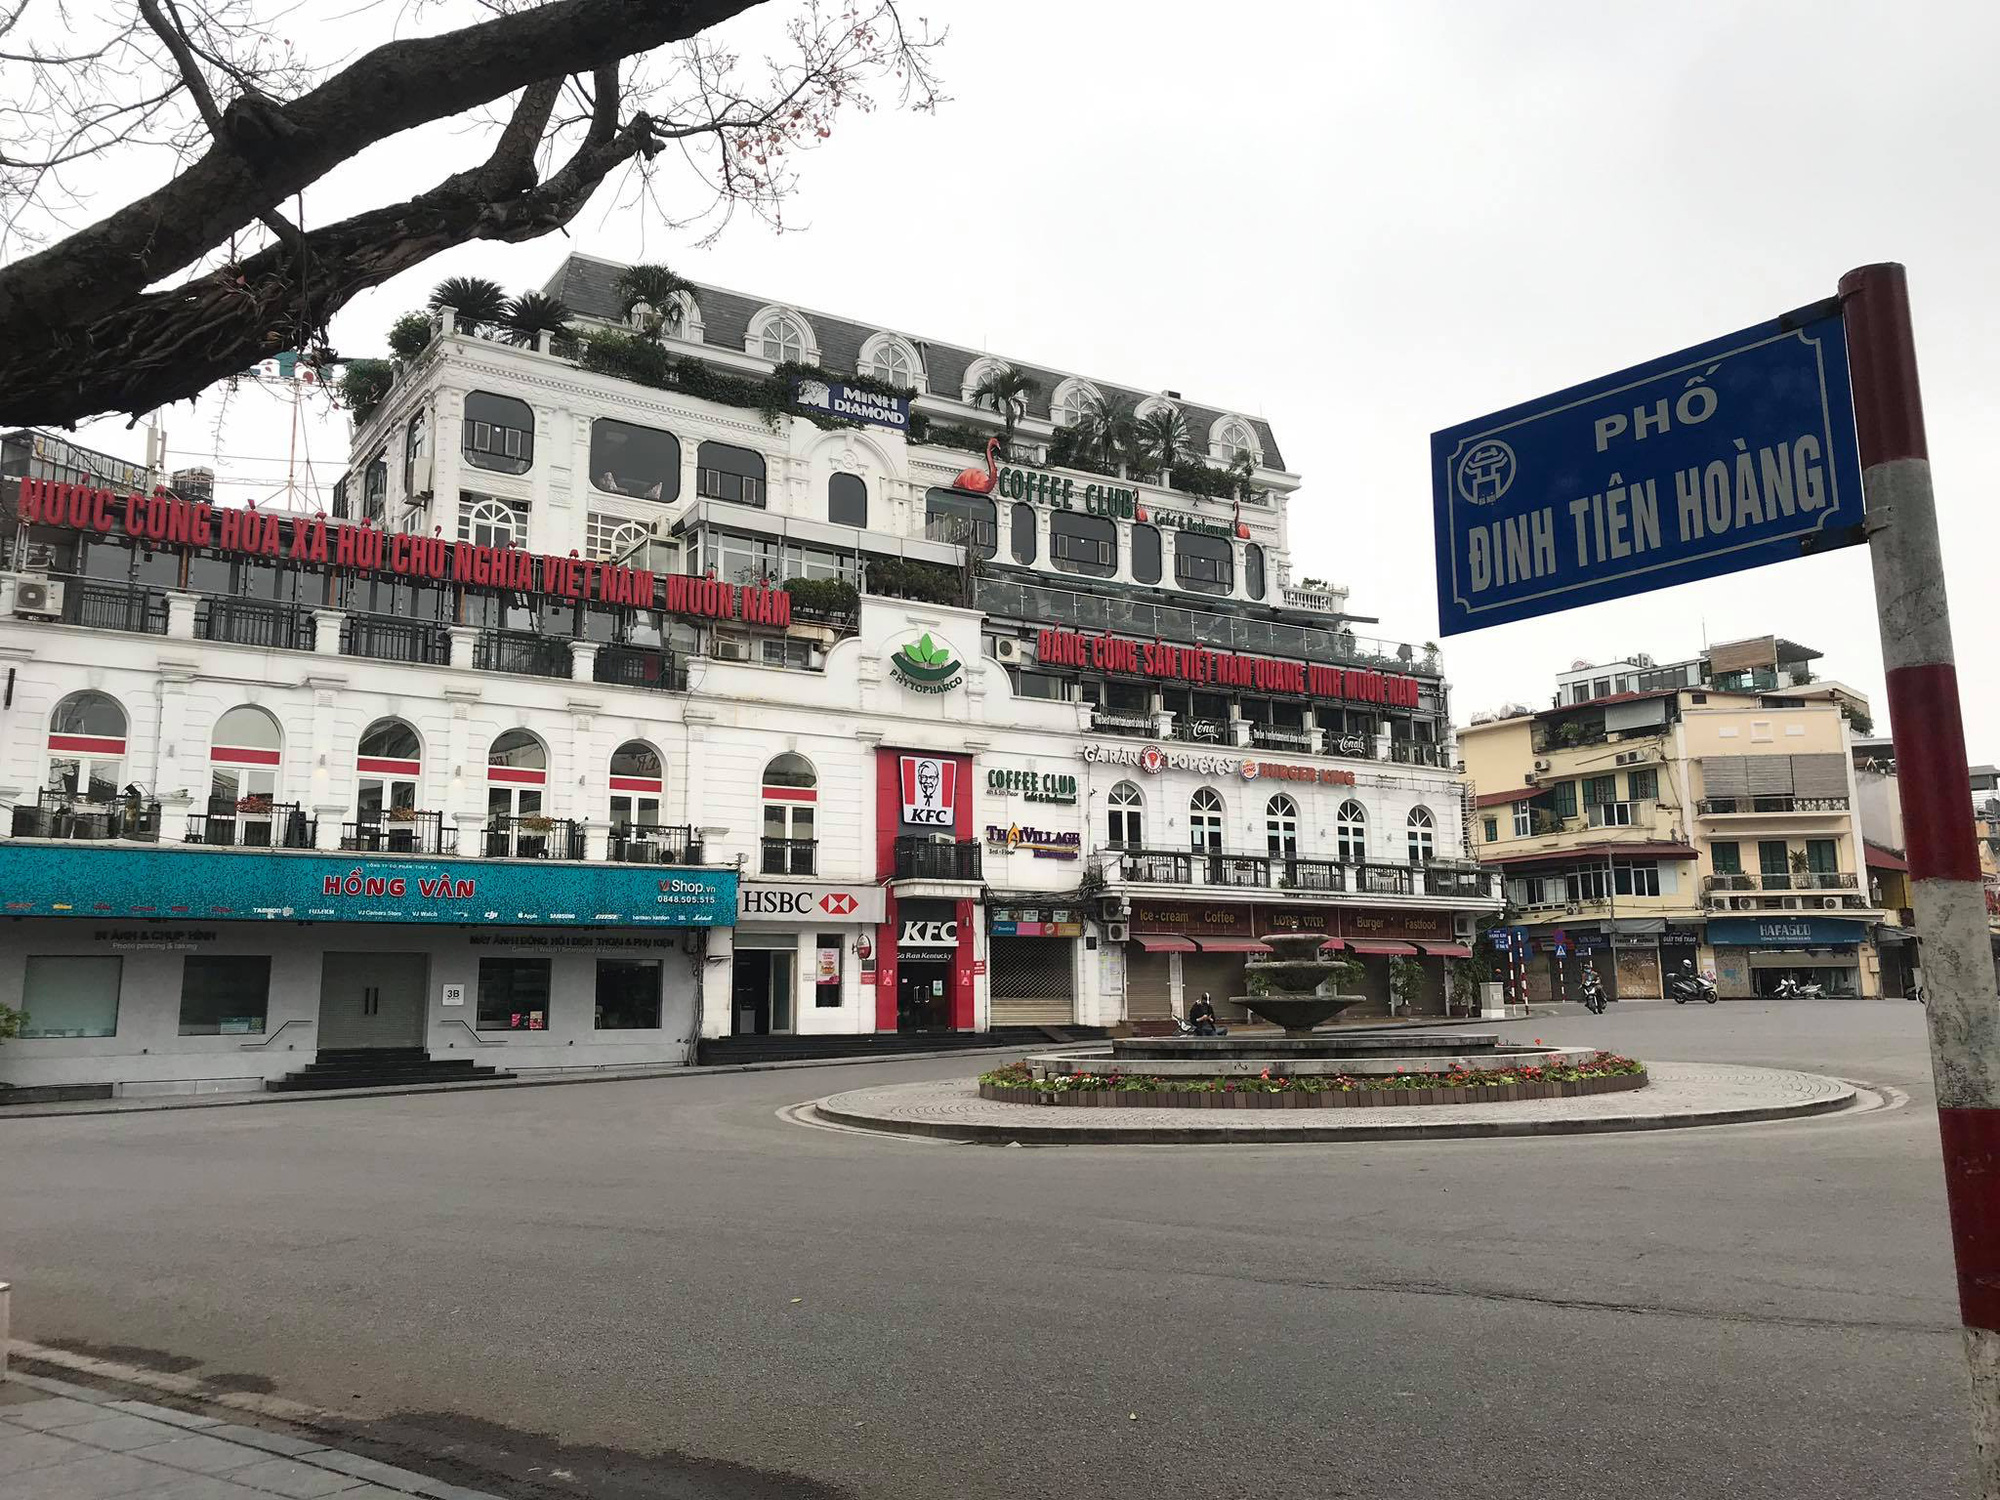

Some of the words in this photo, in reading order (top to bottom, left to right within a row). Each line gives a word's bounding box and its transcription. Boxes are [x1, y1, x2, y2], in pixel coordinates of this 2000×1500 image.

[843, 387, 898, 410] MINH
[1594, 363, 1721, 453] PHỐ
[834, 399, 905, 425] DIAMOND
[1000, 466, 1074, 510] COFFEE
[1085, 484, 1134, 519] CLUB
[1154, 511, 1176, 527] Café
[1177, 515, 1185, 529] &
[1187, 516, 1235, 536] Restaurant
[1468, 506, 1557, 593] ĐINH
[1570, 472, 1661, 568] TIÊN
[1675, 434, 1825, 543] HOÀNG
[18, 469, 115, 531] NƯỚC
[124, 484, 212, 548] CỘNG
[290, 511, 328, 563] XÃ
[337, 517, 384, 578] HỘI
[391, 525, 447, 578] CHỦ
[453, 541, 533, 592] NGHĨA
[543, 549, 596, 605] VIỆT
[599, 563, 655, 608] NAM
[666, 570, 735, 618] MUÔN
[741, 578, 791, 627] NĂM
[1038, 620, 1088, 667] ĐẢNG
[1092, 629, 1138, 677] CỘNG
[1143, 634, 1178, 677] SẢN
[1179, 642, 1214, 688] VIỆT
[1216, 652, 1252, 686] NAM
[1253, 657, 1305, 693] QUANG
[1307, 664, 1343, 698] VINH
[1344, 662, 1386, 704] MUÔN
[1387, 671, 1420, 708] NĂM
[889, 669, 963, 694] PHYTOPHARCO
[1083, 744, 1108, 762] GÀ
[1109, 747, 1142, 767] RÁN
[987, 769, 1039, 791] COFFEE
[1042, 773, 1077, 794] CLUB
[1258, 762, 1317, 782] BURGER
[1320, 768, 1356, 787] KING
[910, 808, 947, 823] KFC
[323, 866, 407, 897] HỒNG
[418, 873, 476, 898] VÂN
[657, 895, 715, 903] 0848.505.515
[743, 891, 813, 914] HSBC
[1204, 910, 1235, 924] Coffee
[1357, 916, 1385, 931] Burger
[1405, 918, 1437, 930] Fastfood
[903, 921, 958, 941] KFC
[1760, 924, 1811, 936] HAFASCO
[921, 952, 953, 961] Kentucky
[447, 989, 460, 998] 3B
